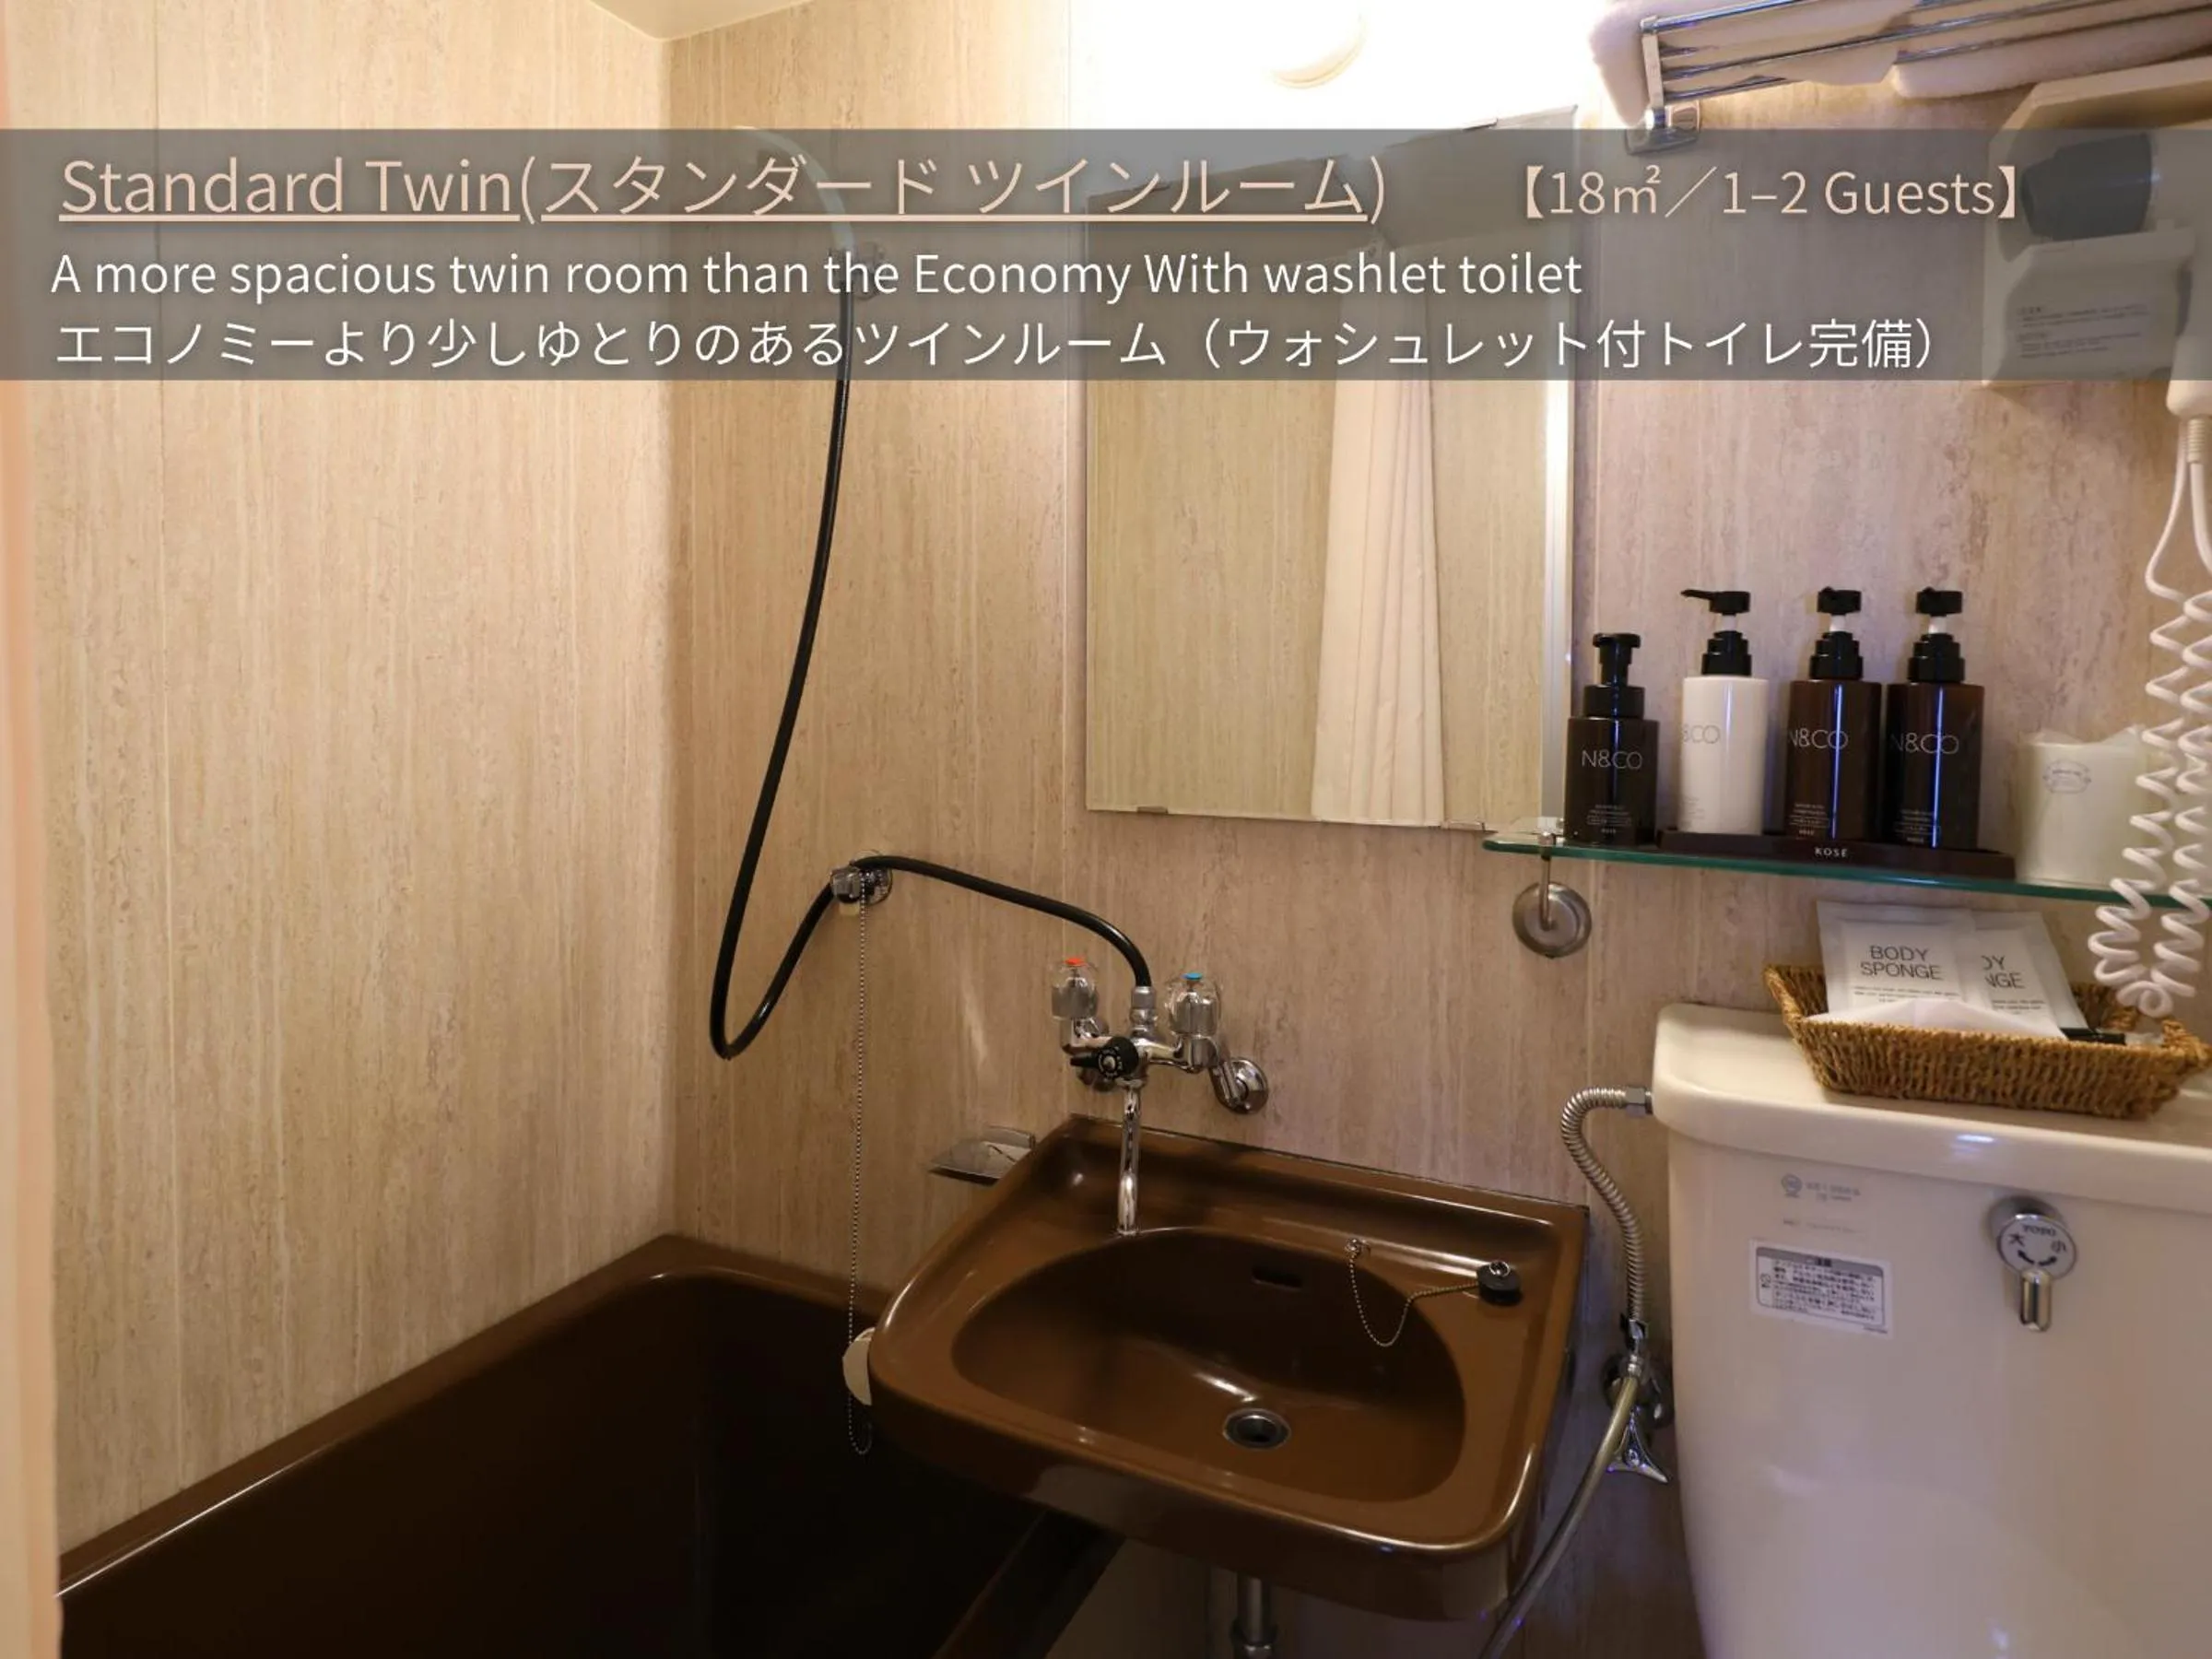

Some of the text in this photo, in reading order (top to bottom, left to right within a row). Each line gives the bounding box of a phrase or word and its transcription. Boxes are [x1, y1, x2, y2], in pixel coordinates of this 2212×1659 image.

[1581, 748, 1643, 771] N&CO
[1869, 944, 1930, 962] BODY
[1860, 961, 1945, 982] SPONGE
